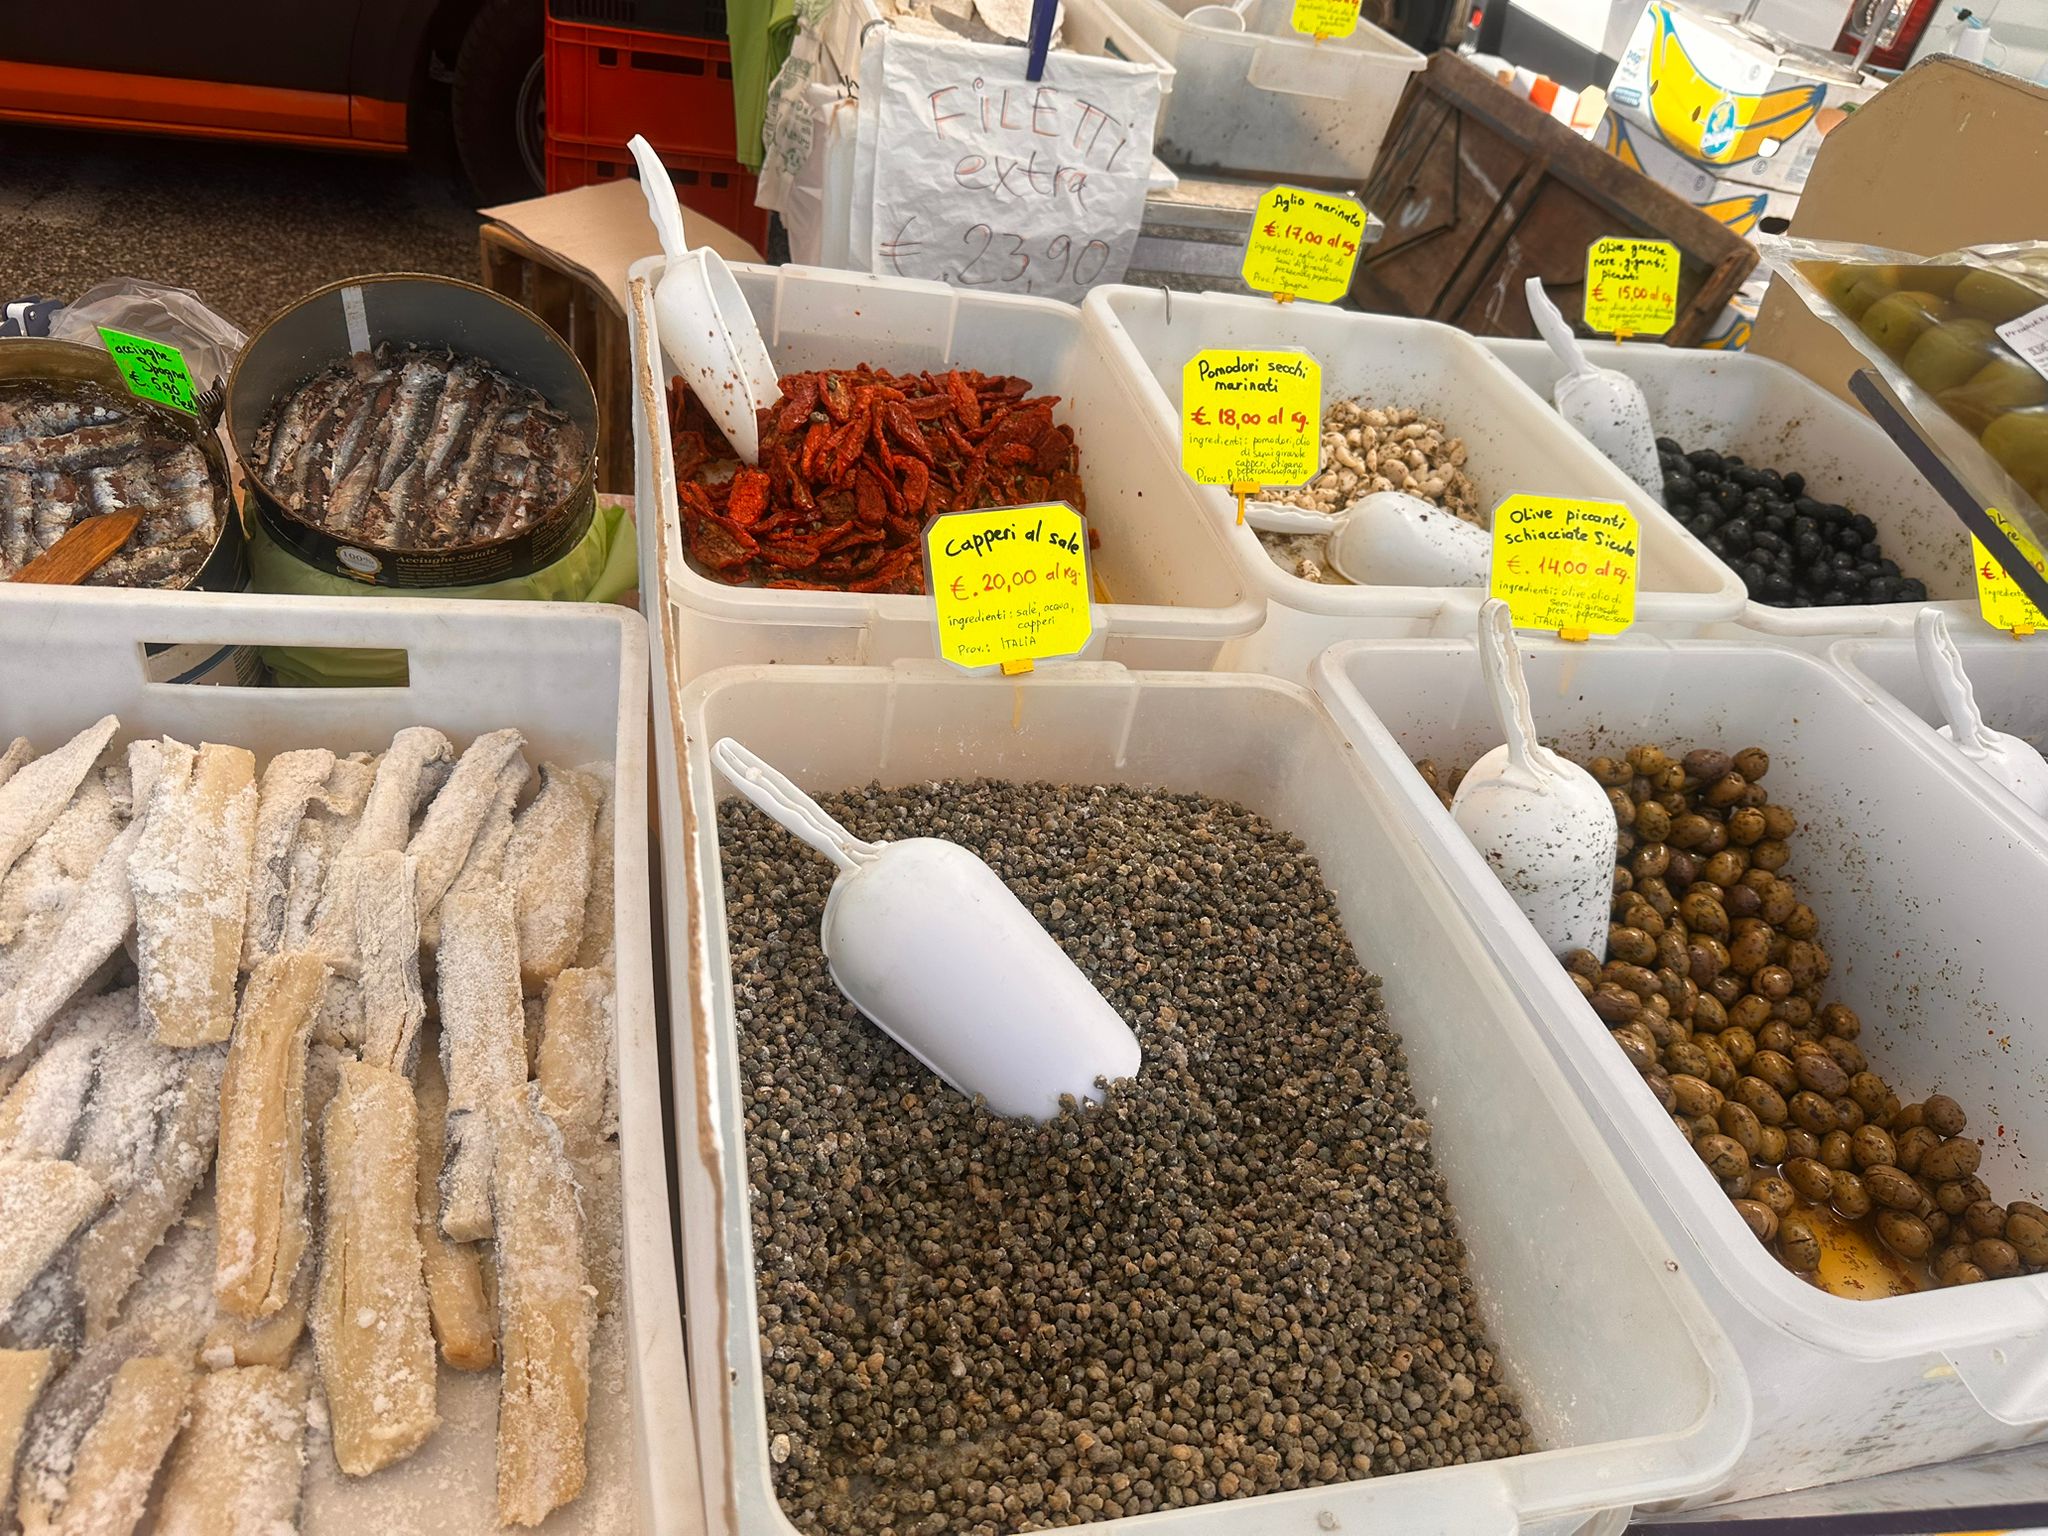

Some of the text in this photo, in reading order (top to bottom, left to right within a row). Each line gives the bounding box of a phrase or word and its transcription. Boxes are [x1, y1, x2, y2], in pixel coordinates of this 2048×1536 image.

[954, 151, 1089, 213] extra
[1272, 193, 1361, 228] Aglio marinato
[1285, 224, 1323, 246] 17,00
[1327, 233, 1342, 248] al
[1198, 356, 1259, 381] Pomodori
[1214, 377, 1279, 392] marinati
[1191, 406, 1212, 425] €
[1218, 408, 1261, 430] 18,00
[1267, 407, 1283, 424] al
[945, 519, 1080, 557] Capperi al sale
[1045, 562, 1059, 580] al
[1539, 556, 1588, 578] 14,00
[1595, 560, 1610, 576] al
[1018, 616, 1055, 633] capperi
